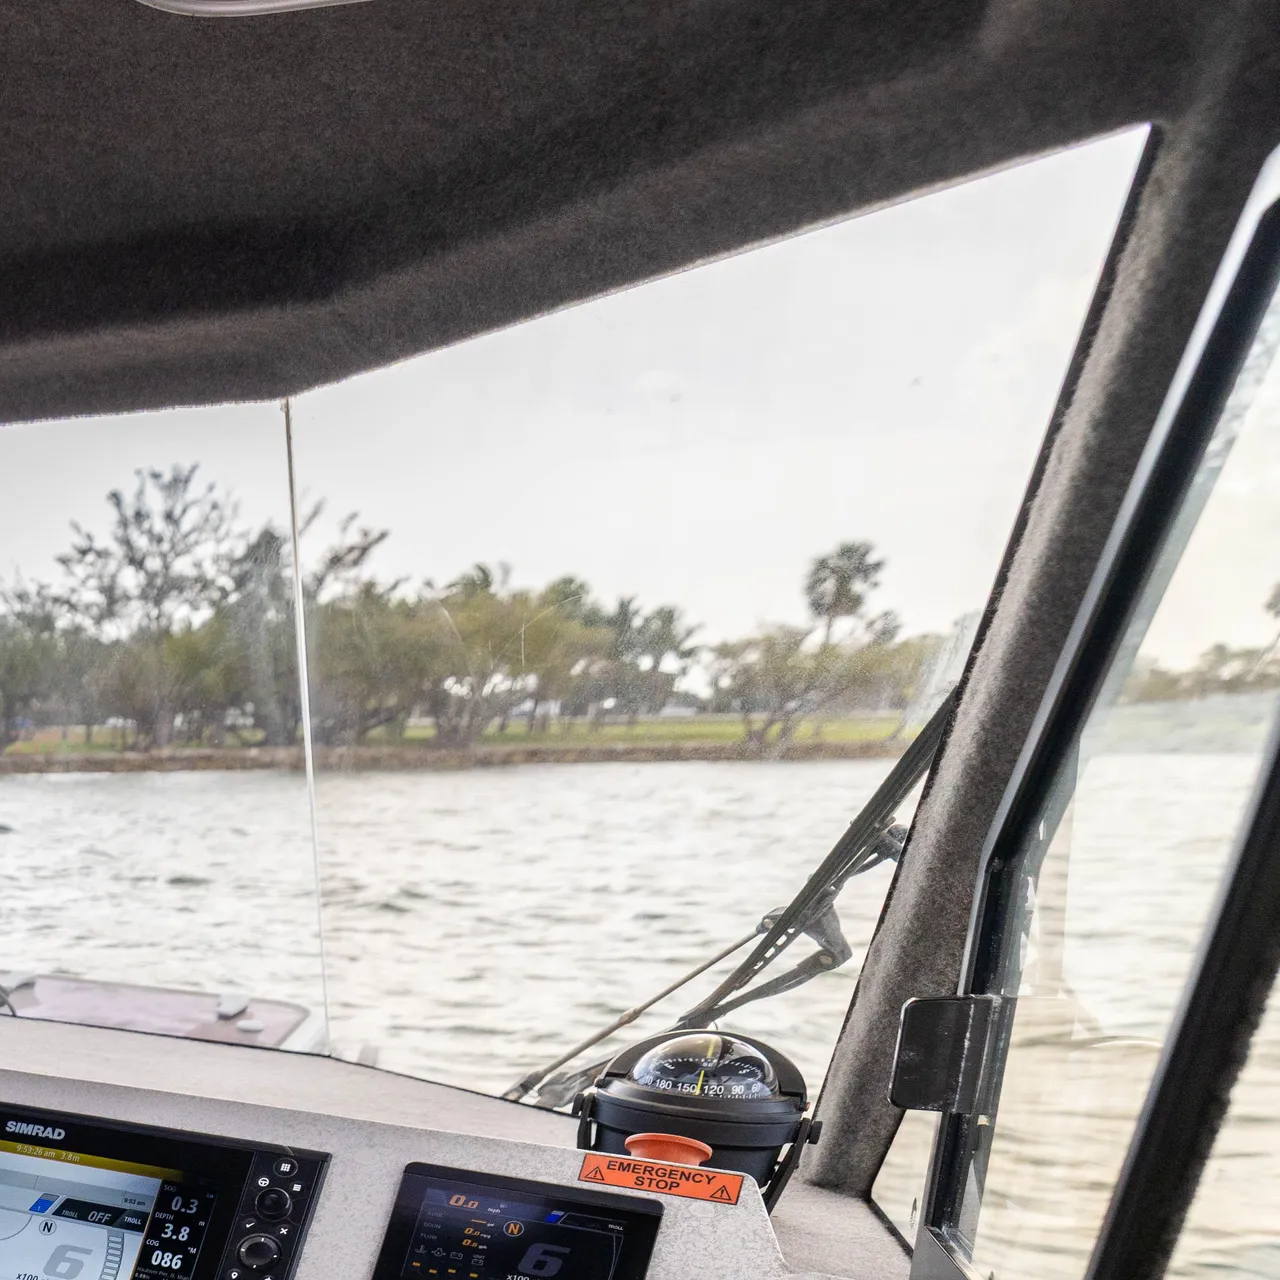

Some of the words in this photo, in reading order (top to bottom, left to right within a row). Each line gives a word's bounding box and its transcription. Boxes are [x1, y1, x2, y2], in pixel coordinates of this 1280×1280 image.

[655, 1079, 672, 1090] 180
[677, 1083, 696, 1093] 150
[703, 1086, 724, 1095] 120
[731, 1085, 745, 1094] 90
[5, 1120, 66, 1140] SIMRAD
[16, 1144, 43, 1156] 9:53:26
[43, 1150, 55, 1158] am
[60, 1152, 80, 1162] 3.8m
[606, 1160, 716, 1185] EMERGENCY
[634, 1176, 680, 1191] STOP
[171, 1196, 199, 1213] 0.3
[449, 1194, 479, 1209] 0.0
[88, 1211, 112, 1223] OFF
[124, 1216, 142, 1225] TROLL
[155, 1212, 174, 1221] DEPTH
[42, 1222, 53, 1233] N
[161, 1223, 190, 1241] 3.8
[508, 1223, 519, 1235] N
[146, 1239, 159, 1247] COG
[43, 1244, 93, 1280] 6
[151, 1250, 183, 1270] 086
[518, 1243, 571, 1277] 6
